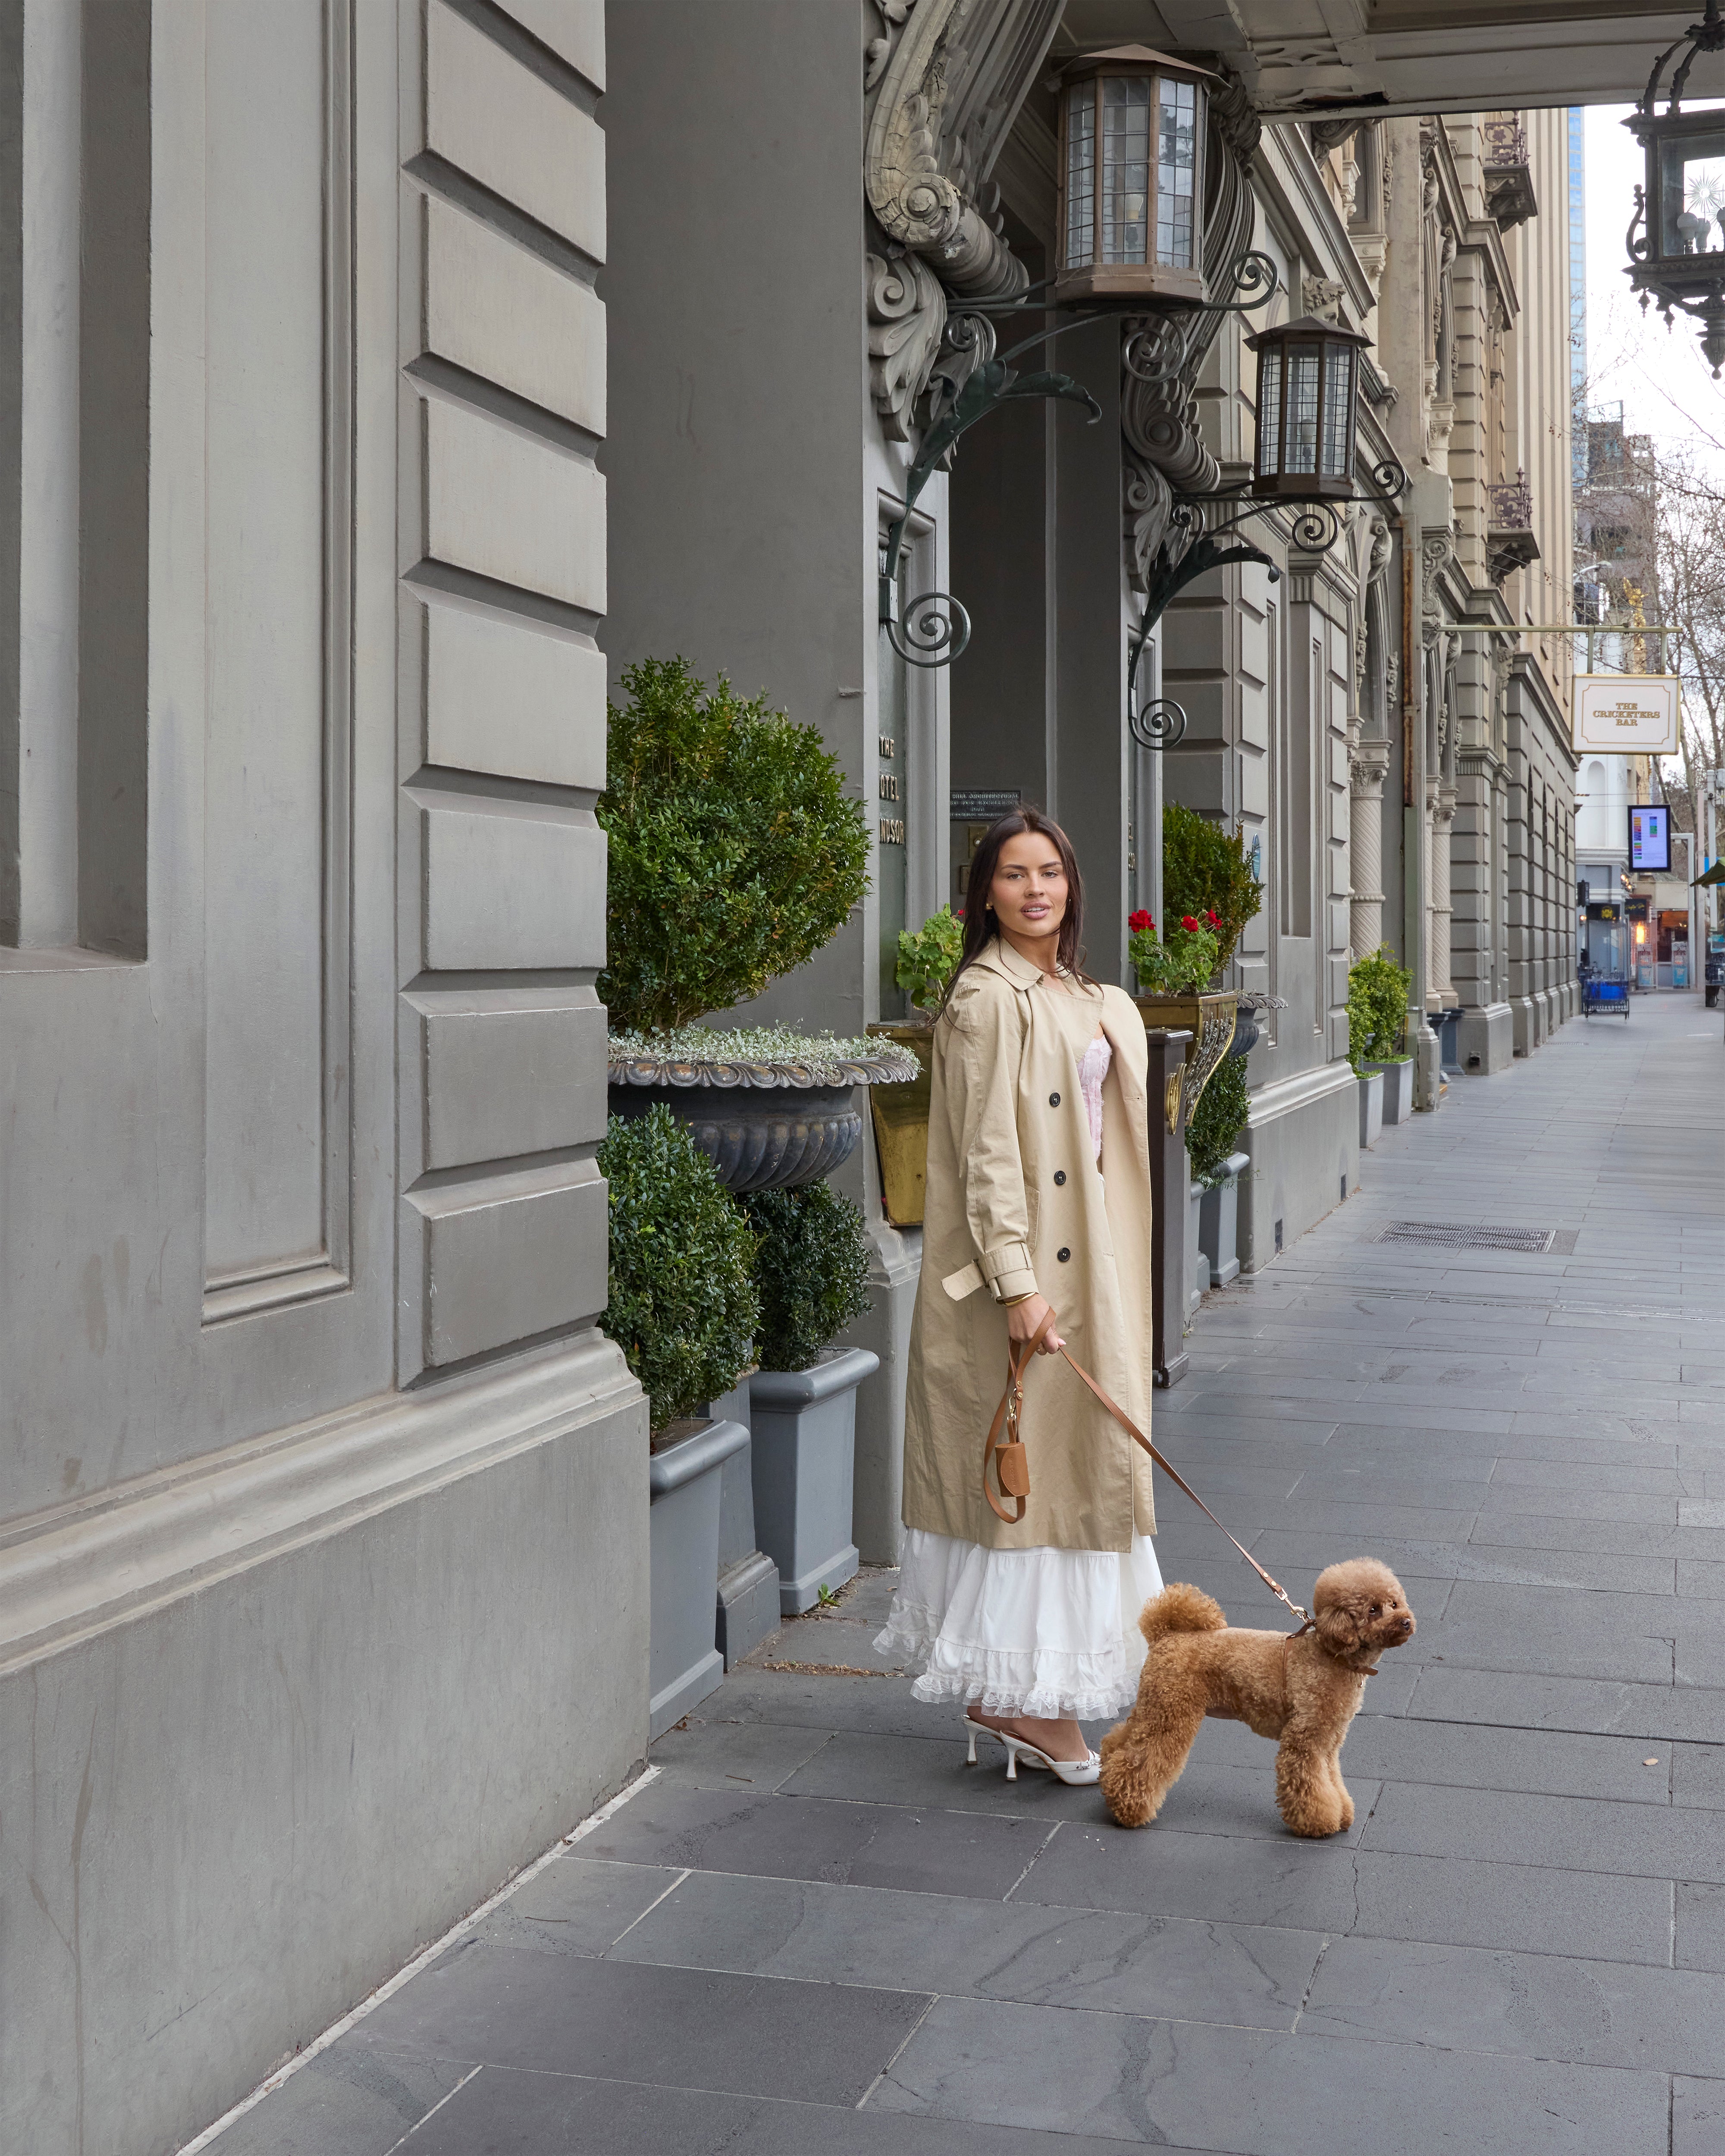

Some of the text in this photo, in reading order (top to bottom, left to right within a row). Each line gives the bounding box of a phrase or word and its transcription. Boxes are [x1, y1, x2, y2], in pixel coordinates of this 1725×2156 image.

[879, 736, 894, 757] THE
[880, 775, 899, 801] OTEL
[880, 818, 904, 844] NDSOR
